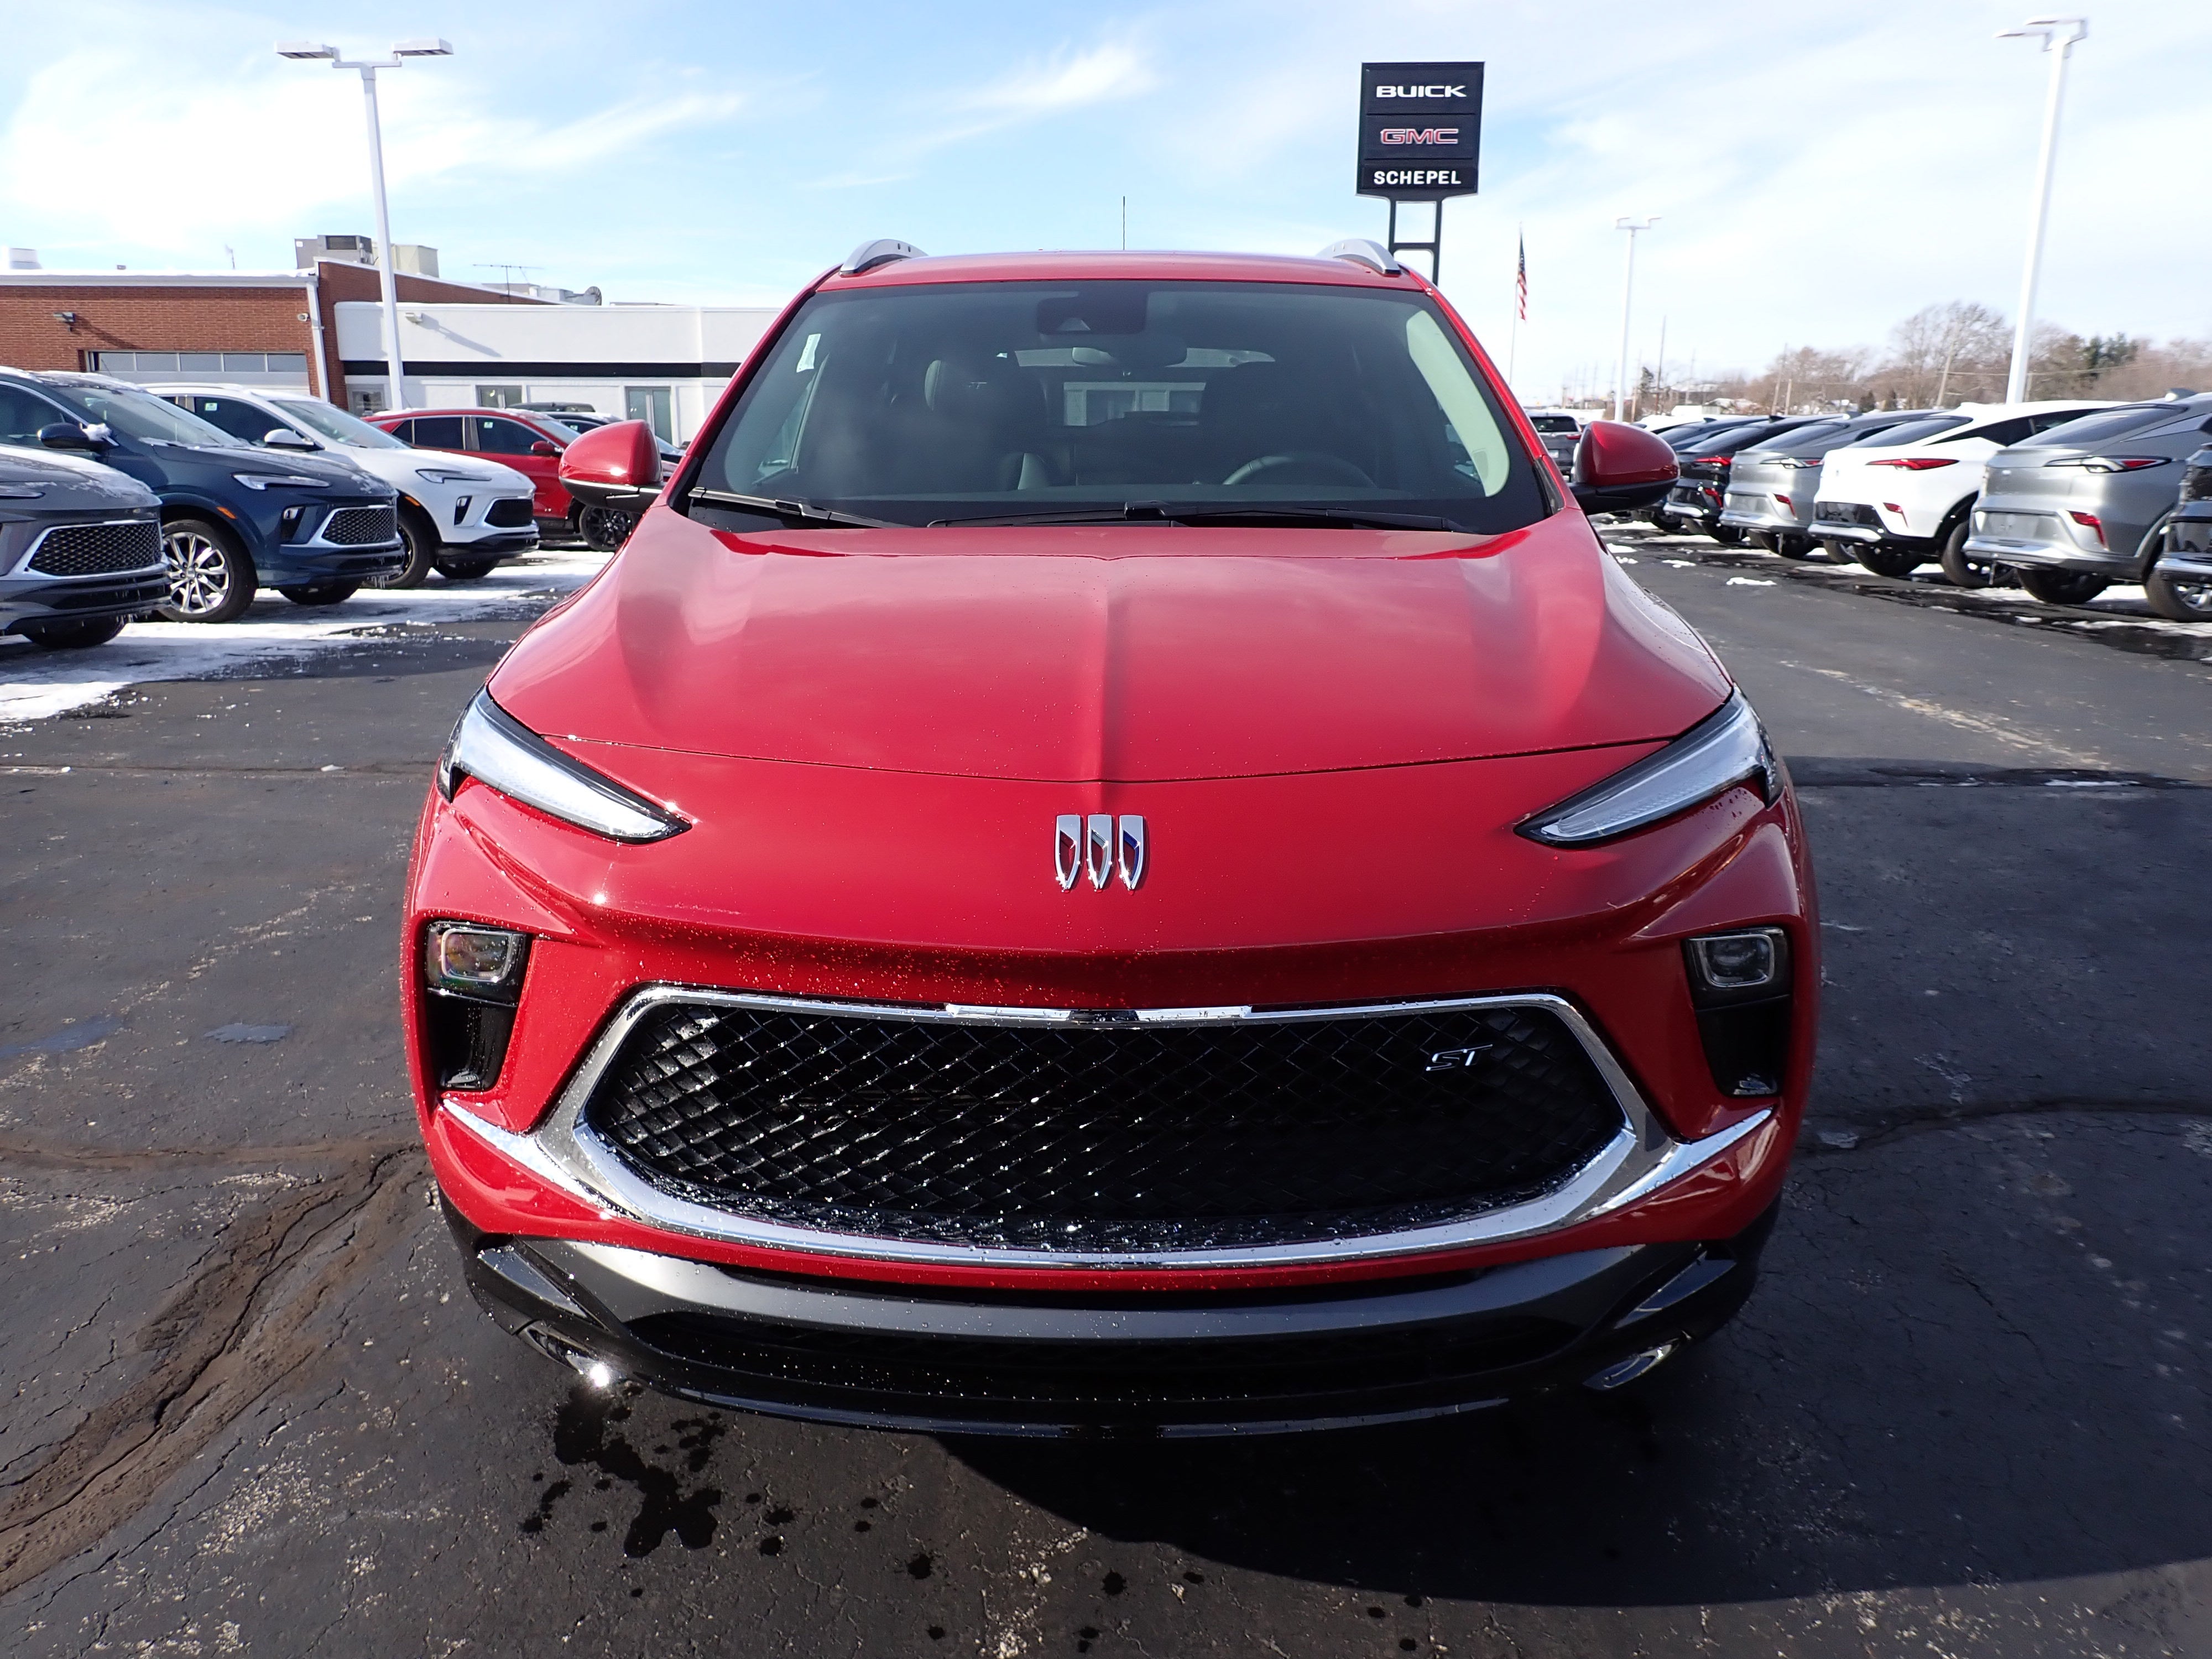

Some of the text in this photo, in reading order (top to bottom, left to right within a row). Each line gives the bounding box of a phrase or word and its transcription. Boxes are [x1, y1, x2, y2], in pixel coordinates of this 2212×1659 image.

[1376, 86, 1467, 97] BUICK
[1380, 128, 1459, 144] GMC
[1374, 170, 1462, 185] SCHEPEL
[1426, 1044, 1493, 1071] ST
